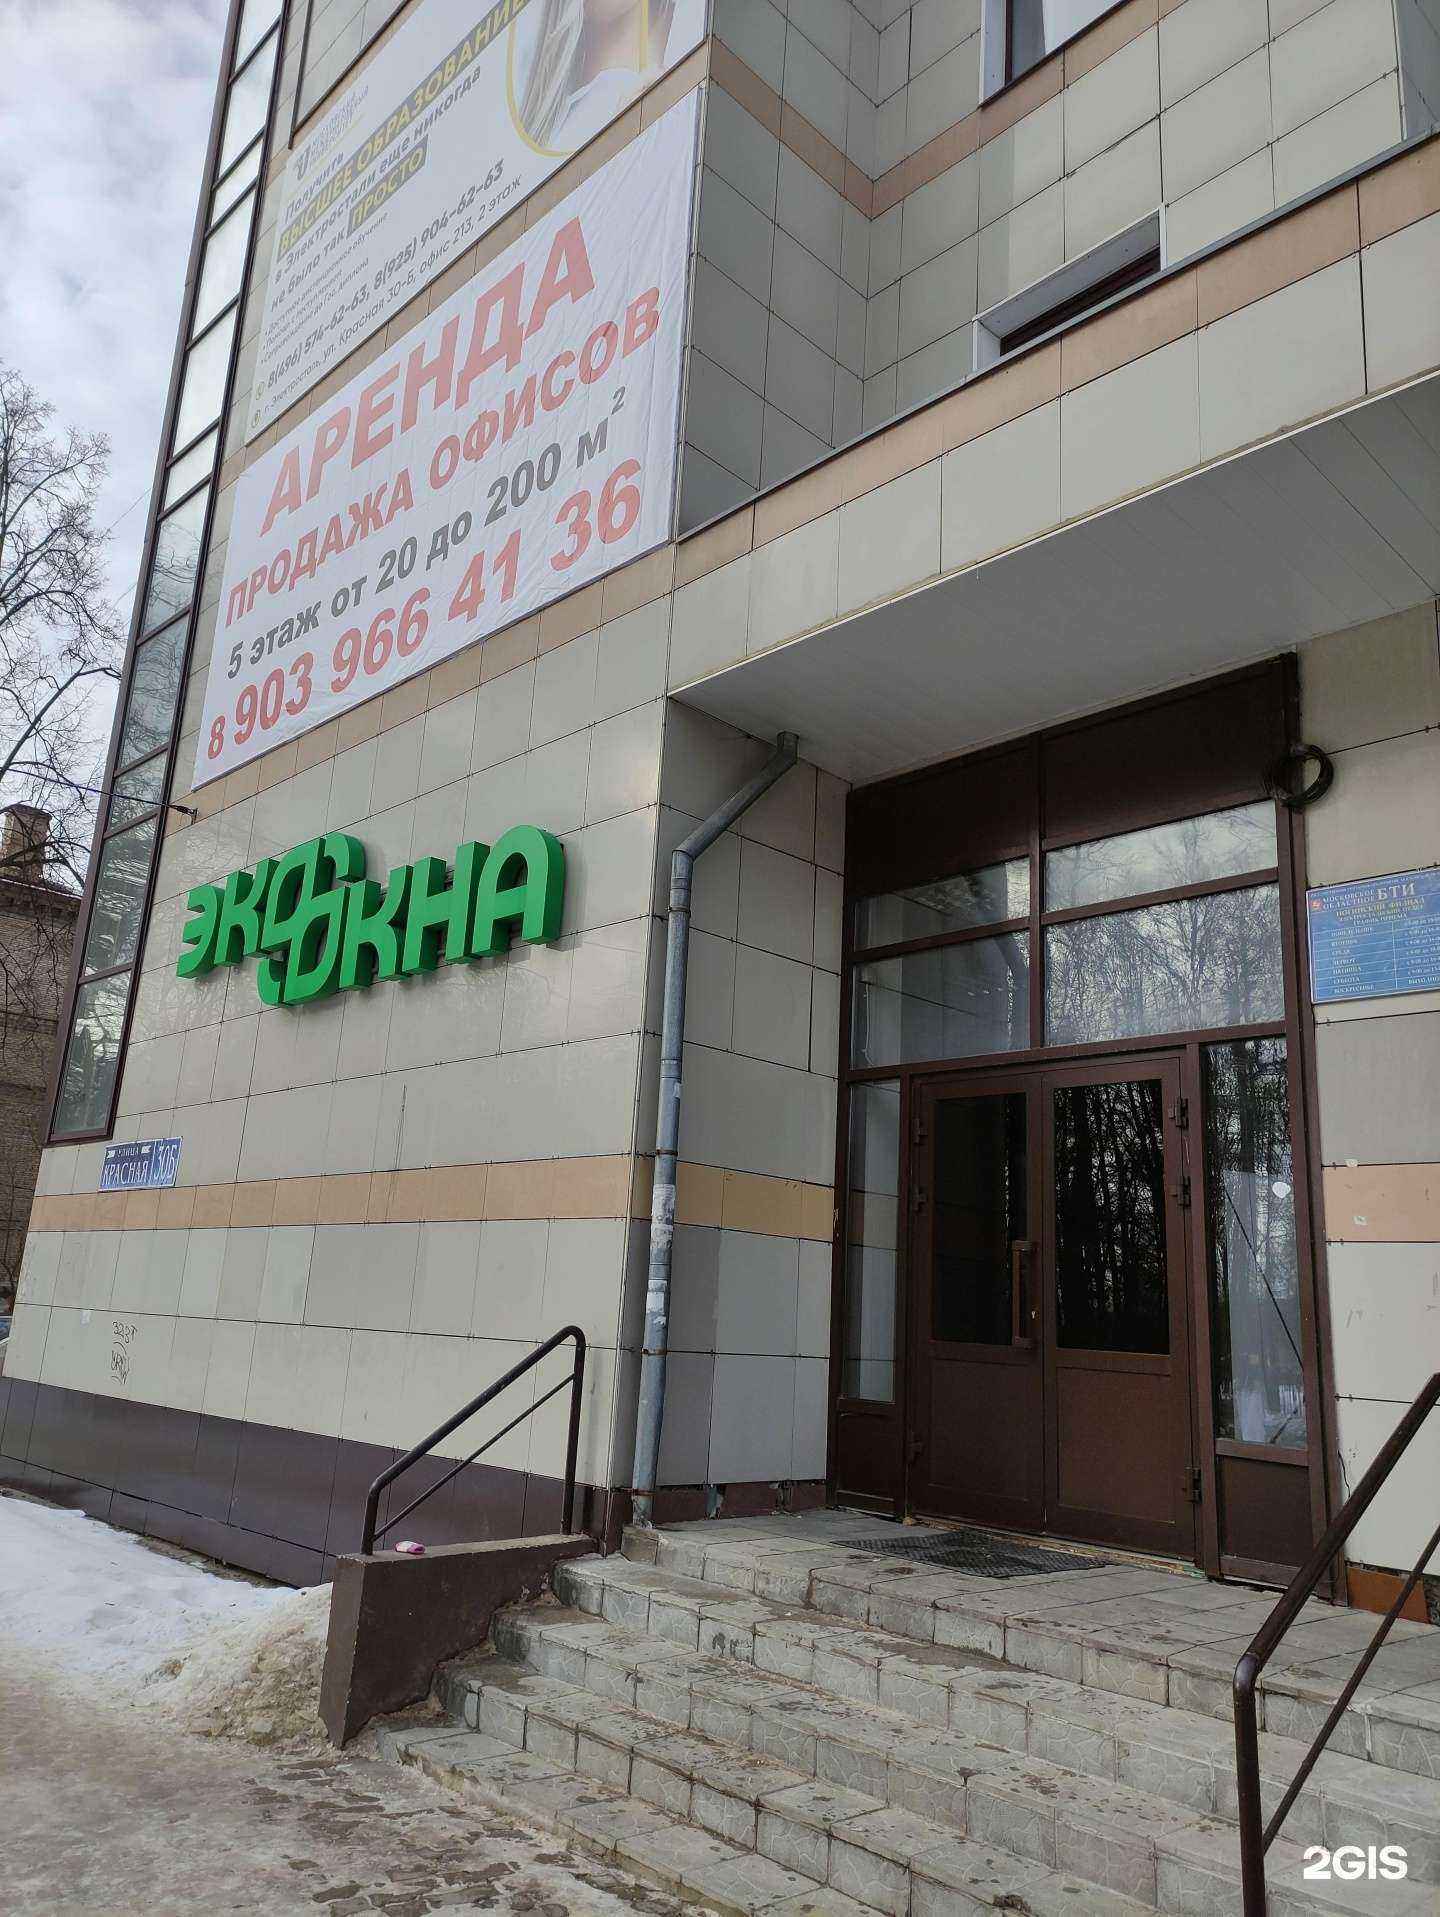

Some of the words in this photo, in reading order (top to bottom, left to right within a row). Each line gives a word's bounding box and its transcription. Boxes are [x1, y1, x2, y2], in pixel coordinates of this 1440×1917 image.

[280, 166, 353, 250] ВЫСШЕЕ
[285, 170, 377, 273] Электростали
[413, 65, 481, 141] никогда
[288, 254, 321, 294] было
[324, 228, 346, 257] так
[352, 148, 423, 226] ПРОСТО
[374, 237, 417, 290] 8(925)
[421, 159, 504, 248] 904-62-63
[419, 240, 450, 273] офис
[477, 204, 486, 222] 2
[488, 174, 522, 212] этаж
[260, 216, 595, 537] АРЕНДА
[226, 468, 414, 628] ПРОДАЖА
[429, 286, 661, 490] ОФИСОВ
[207, 715, 226, 760] 8
[233, 651, 314, 746] 903
[330, 587, 431, 693] 966
[447, 528, 522, 623] 41
[549, 458, 642, 572] 36
[228, 642, 243, 679] 5
[250, 601, 321, 665] этаж
[331, 576, 368, 618] от
[374, 536, 418, 593] 20
[426, 511, 472, 570] до
[484, 442, 562, 527] 200
[1376, 882, 1416, 901] БТИ
[102, 1160, 148, 1186] КРАСНАЯ
[154, 1145, 177, 1180] 30Б
[117, 1147, 139, 1157] УЛИЦА
